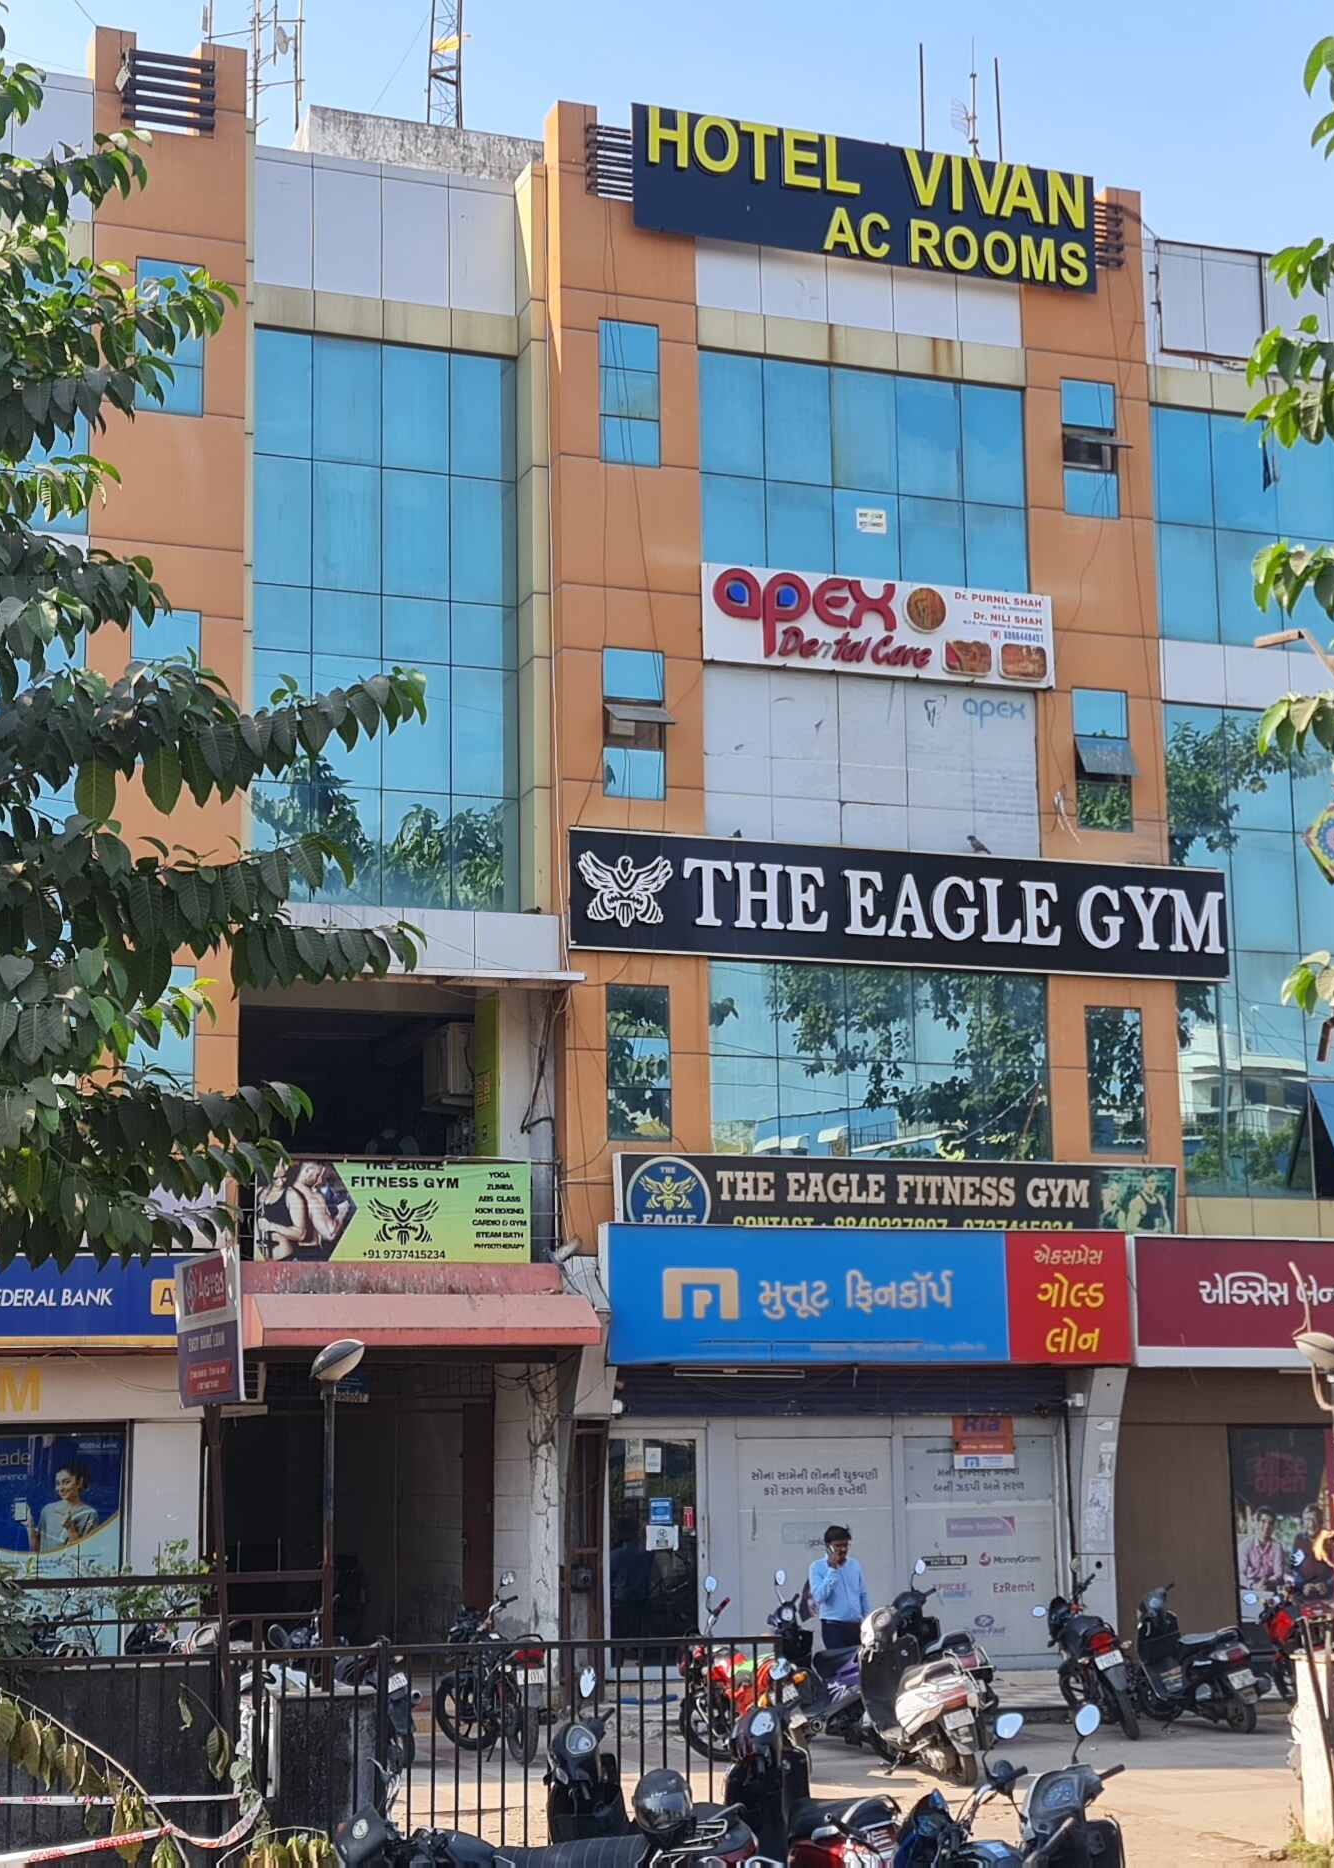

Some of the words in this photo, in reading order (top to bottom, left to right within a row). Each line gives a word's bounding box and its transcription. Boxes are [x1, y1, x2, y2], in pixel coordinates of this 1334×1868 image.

[646, 105, 861, 196] HOTEL
[903, 147, 1085, 230] VIVAN
[822, 207, 891, 259] AC
[909, 218, 1089, 288] ROOMS
[954, 591, 967, 601] Dr.
[971, 593, 1010, 604] PURNIL
[1013, 597, 1042, 608] SHAH
[973, 611, 987, 620] Dr.
[990, 613, 1010, 622] NILI
[1014, 615, 1042, 625] SHAH
[778, 625, 872, 662] Dental
[871, 635, 932, 668] Care
[683, 857, 828, 932] THE
[843, 868, 1062, 946] EAGLE
[1078, 885, 1224, 954] GYM
[488, 1171, 511, 1179] YOGA
[659, 1166, 677, 1174] THE
[351, 1176, 419, 1189] FITNESS
[423, 1177, 459, 1189] GYM
[486, 1183, 514, 1191] ZUMBA
[716, 1171, 775, 1202] THE
[787, 1172, 886, 1204] EAGLE
[896, 1174, 1016, 1206] FITNESS
[1026, 1177, 1090, 1208] GYM
[478, 1195, 494, 1203] ABS
[496, 1195, 521, 1203] CLASS
[494, 1207, 524, 1215] BOXING
[472, 1219, 501, 1227] CARDIO
[509, 1219, 527, 1227] GYM
[475, 1231, 501, 1239] STEAM
[503, 1231, 524, 1239] BATH
[363, 1249, 381, 1259] +91
[383, 1249, 446, 1260] 9737415234
[1036, 1272, 1105, 1308] ગોલ્ડ
[1198, 1271, 1289, 1306] એક્સિસ
[60, 1287, 114, 1307] BANK
[188, 1337, 199, 1352] EASY
[213, 1331, 225, 1347] LOAN
[1046, 1317, 1100, 1353] લોન
[993, 1555, 1042, 1566] MoneyGram
[993, 1581, 1035, 1593] EzRemit
